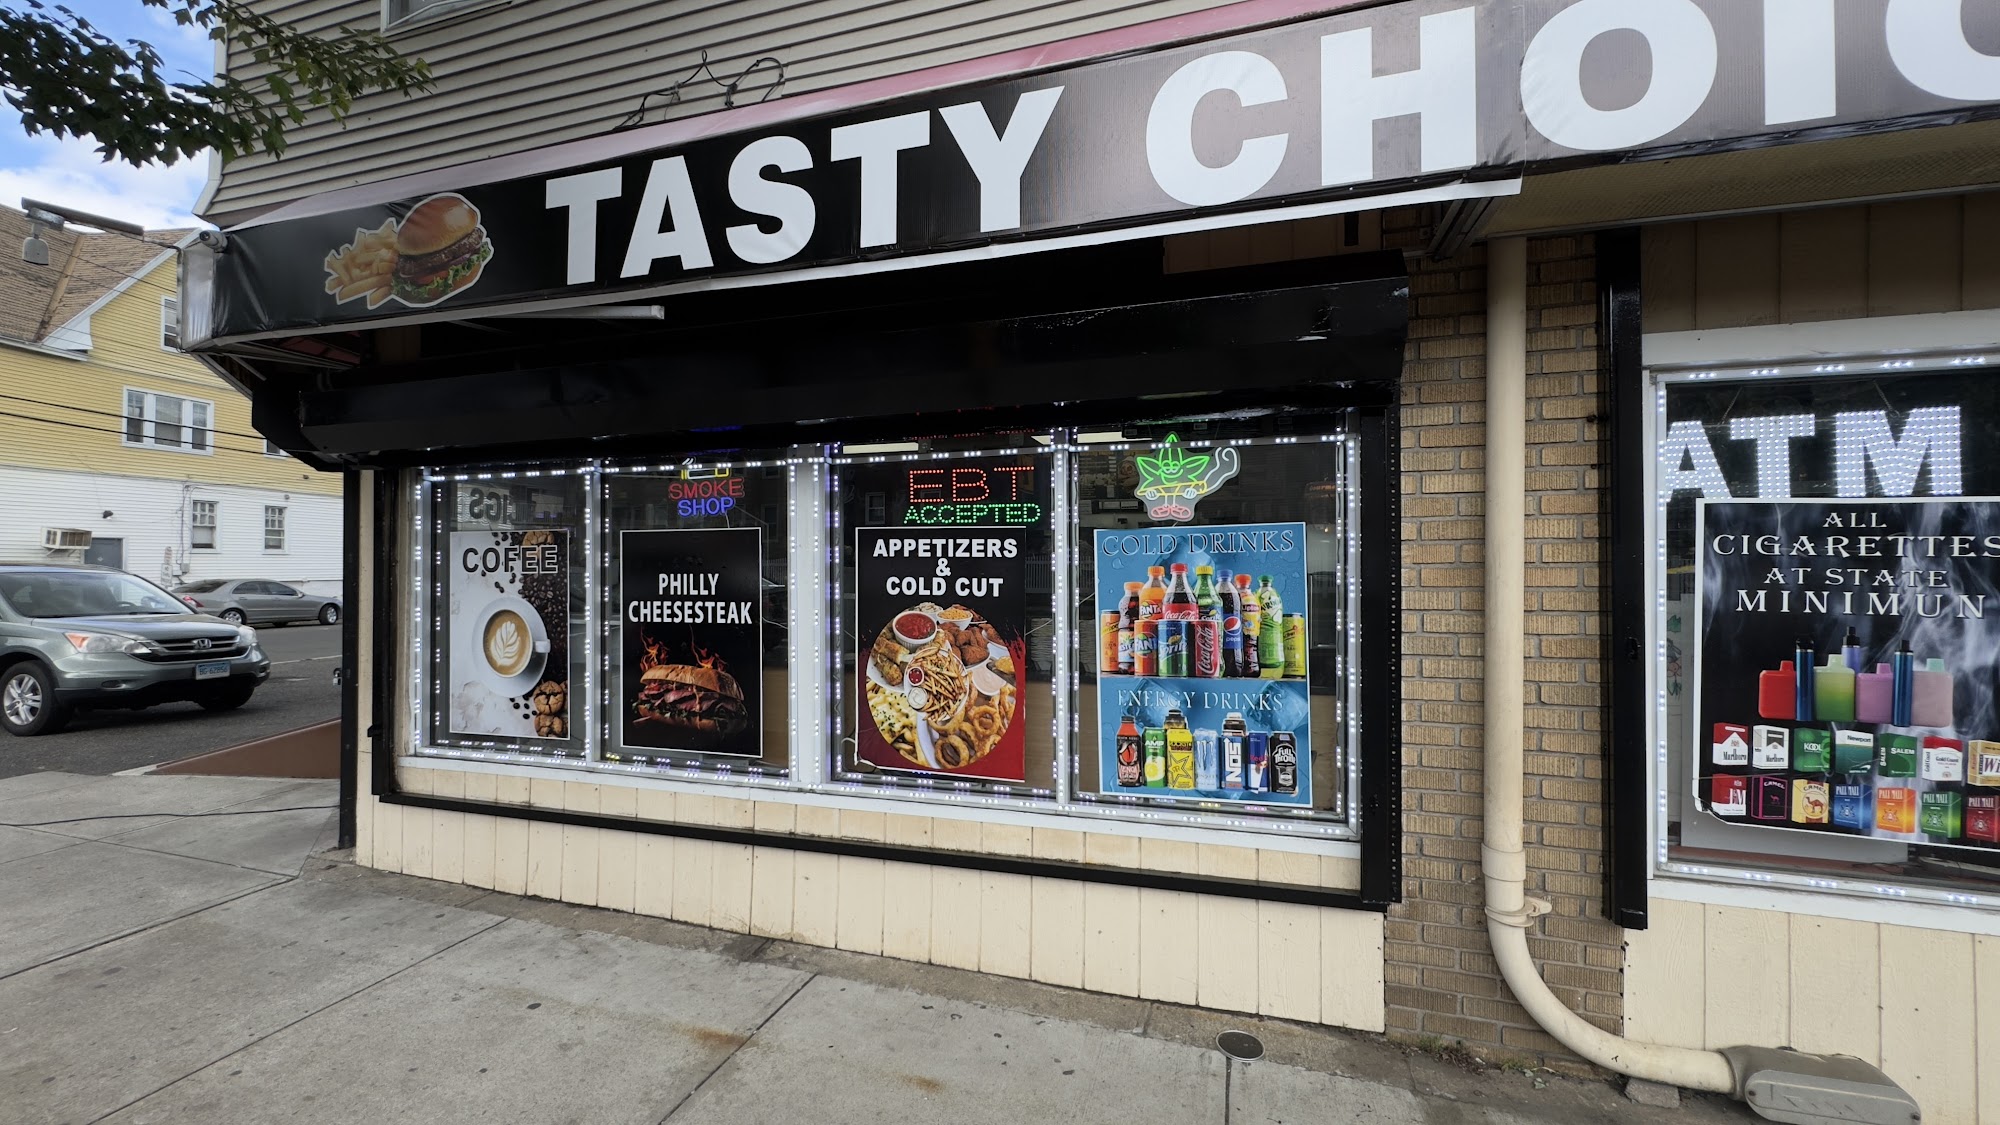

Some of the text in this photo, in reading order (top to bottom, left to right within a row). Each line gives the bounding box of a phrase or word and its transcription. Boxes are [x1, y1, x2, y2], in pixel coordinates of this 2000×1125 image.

[544, 85, 1066, 286] TASTY
[1664, 405, 1963, 503] ATM
[668, 477, 745, 500] SMOKE
[909, 466, 1035, 503] EBT
[677, 496, 735, 517] SHOP
[903, 503, 1041, 524] ACCEPTED
[1822, 512, 1888, 528] ALL
[873, 538, 1018, 558] APPETIZERS
[1101, 530, 1295, 556] COLD DRINKS
[1712, 533, 2000, 558] CIGARETTES
[462, 545, 559, 574] COFEE
[935, 558, 951, 577] &
[658, 573, 719, 596] PHILLY
[886, 577, 1004, 598] COLD CUT
[1763, 567, 1949, 588] AT STATE
[628, 600, 753, 625] CHEESESTEAK
[1735, 589, 1987, 619] MINIMUN
[1117, 689, 1284, 711] ENERGY DRINKS
[1803, 742, 1823, 751] KOOL
[1847, 735, 1872, 743] Newport
[1223, 737, 1242, 782] NOS
[1723, 748, 1747, 761] Marlboro
[1765, 753, 1785, 763] Marlboro
[1890, 747, 1915, 755] SALEM
[1763, 781, 1786, 790] CAMEL
[1803, 785, 1828, 795] CAMEL
[1836, 785, 1860, 796] PALL MALL
[1878, 789, 1891, 799] PALL
[1923, 793, 1935, 803] PALL
[1968, 797, 1981, 807] PALL
